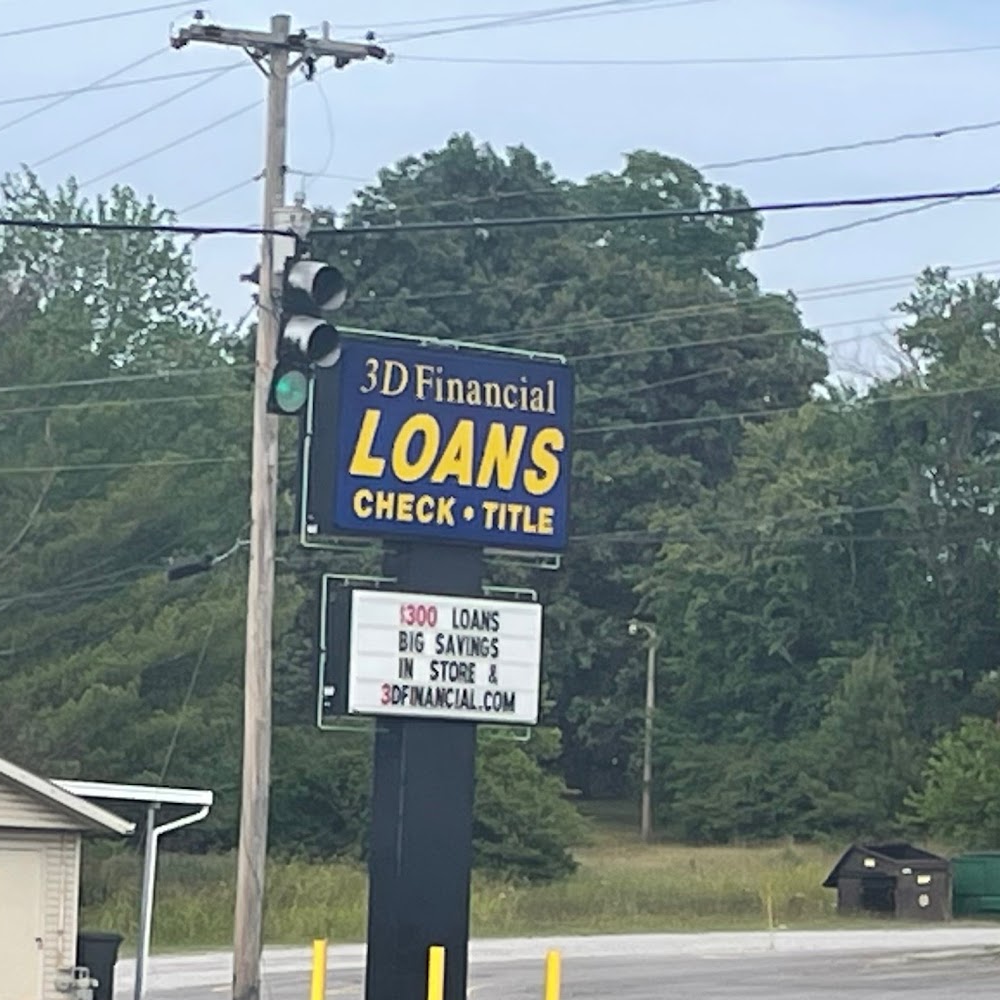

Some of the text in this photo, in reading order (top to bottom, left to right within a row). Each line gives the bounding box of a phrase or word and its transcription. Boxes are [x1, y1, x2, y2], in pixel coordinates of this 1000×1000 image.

[360, 358, 556, 414] 3D Financial
[349, 408, 565, 496] LOANS
[353, 488, 555, 536] CHECK TITLE
[452, 607, 500, 632] LOANS
[398, 630, 499, 658] BIG SAVINGS
[398, 657, 498, 686] IN STORE &
[381, 683, 516, 712] 3DFINANCIAL.COM
